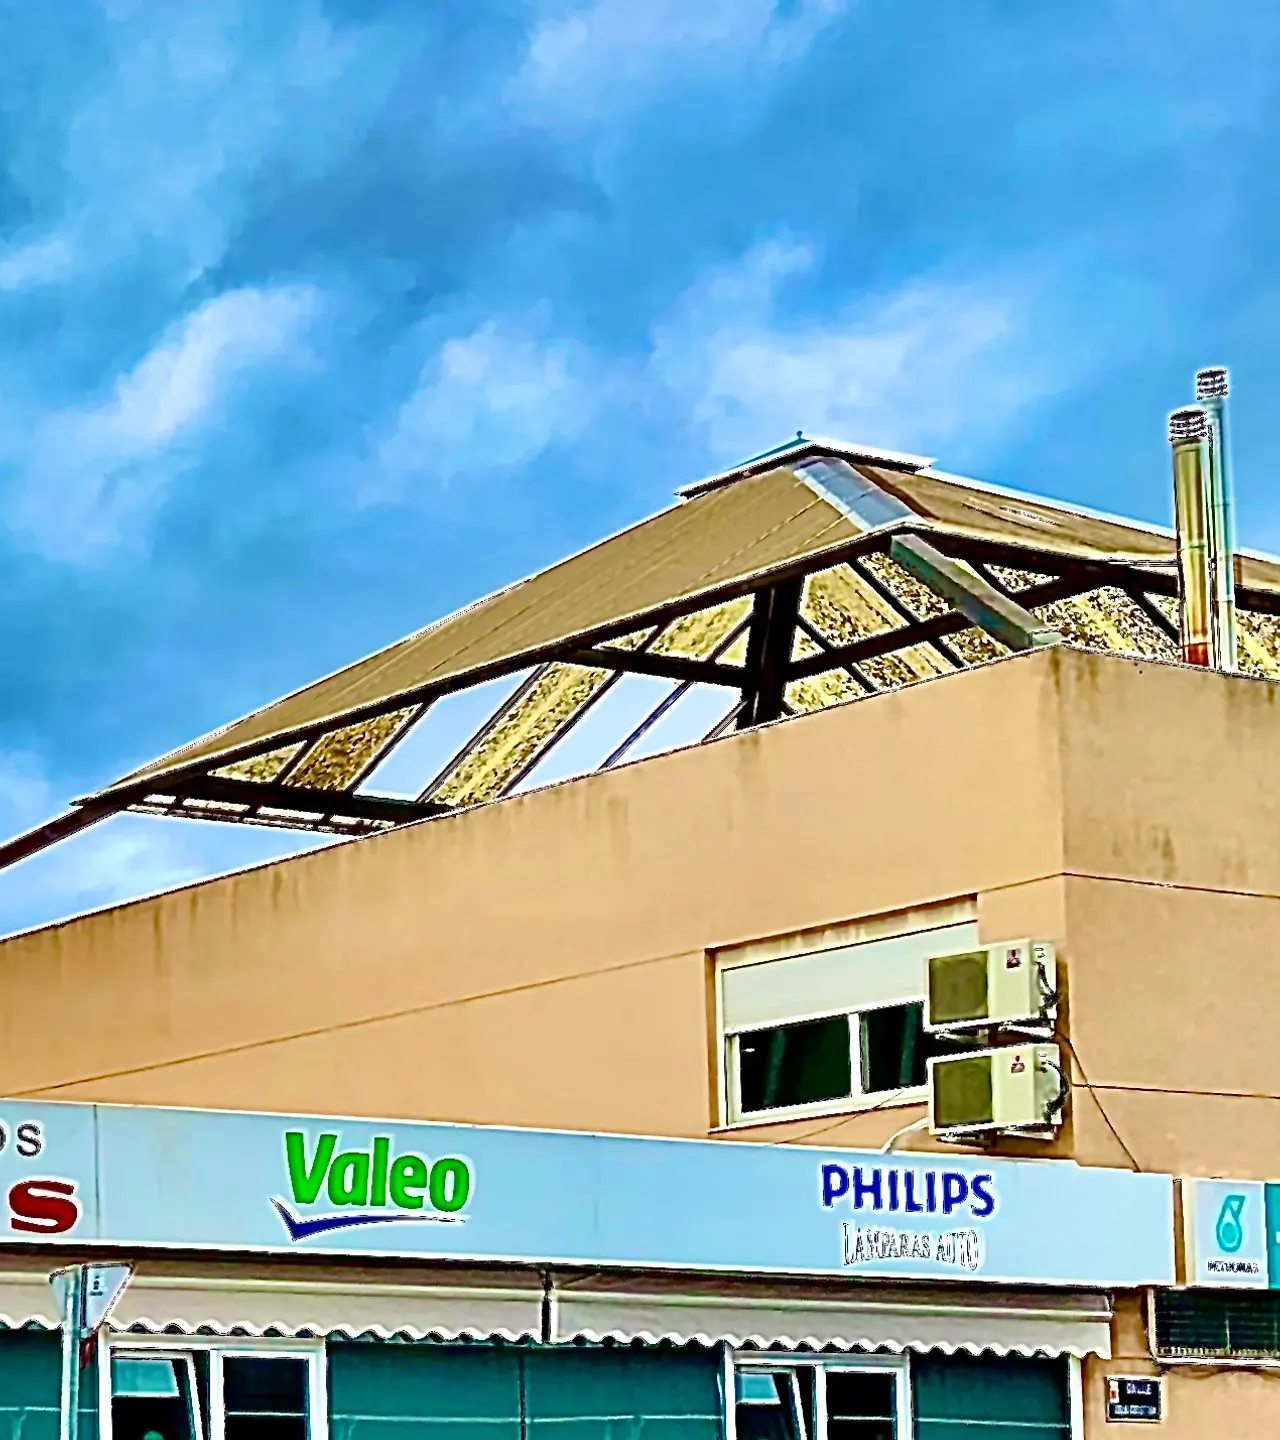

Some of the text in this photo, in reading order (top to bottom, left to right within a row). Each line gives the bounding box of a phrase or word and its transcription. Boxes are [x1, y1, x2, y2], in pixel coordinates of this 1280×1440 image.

[285, 1131, 470, 1213] Valeo
[821, 1164, 996, 1217] PHILIPS
[935, 1229, 979, 1271] AUTO
